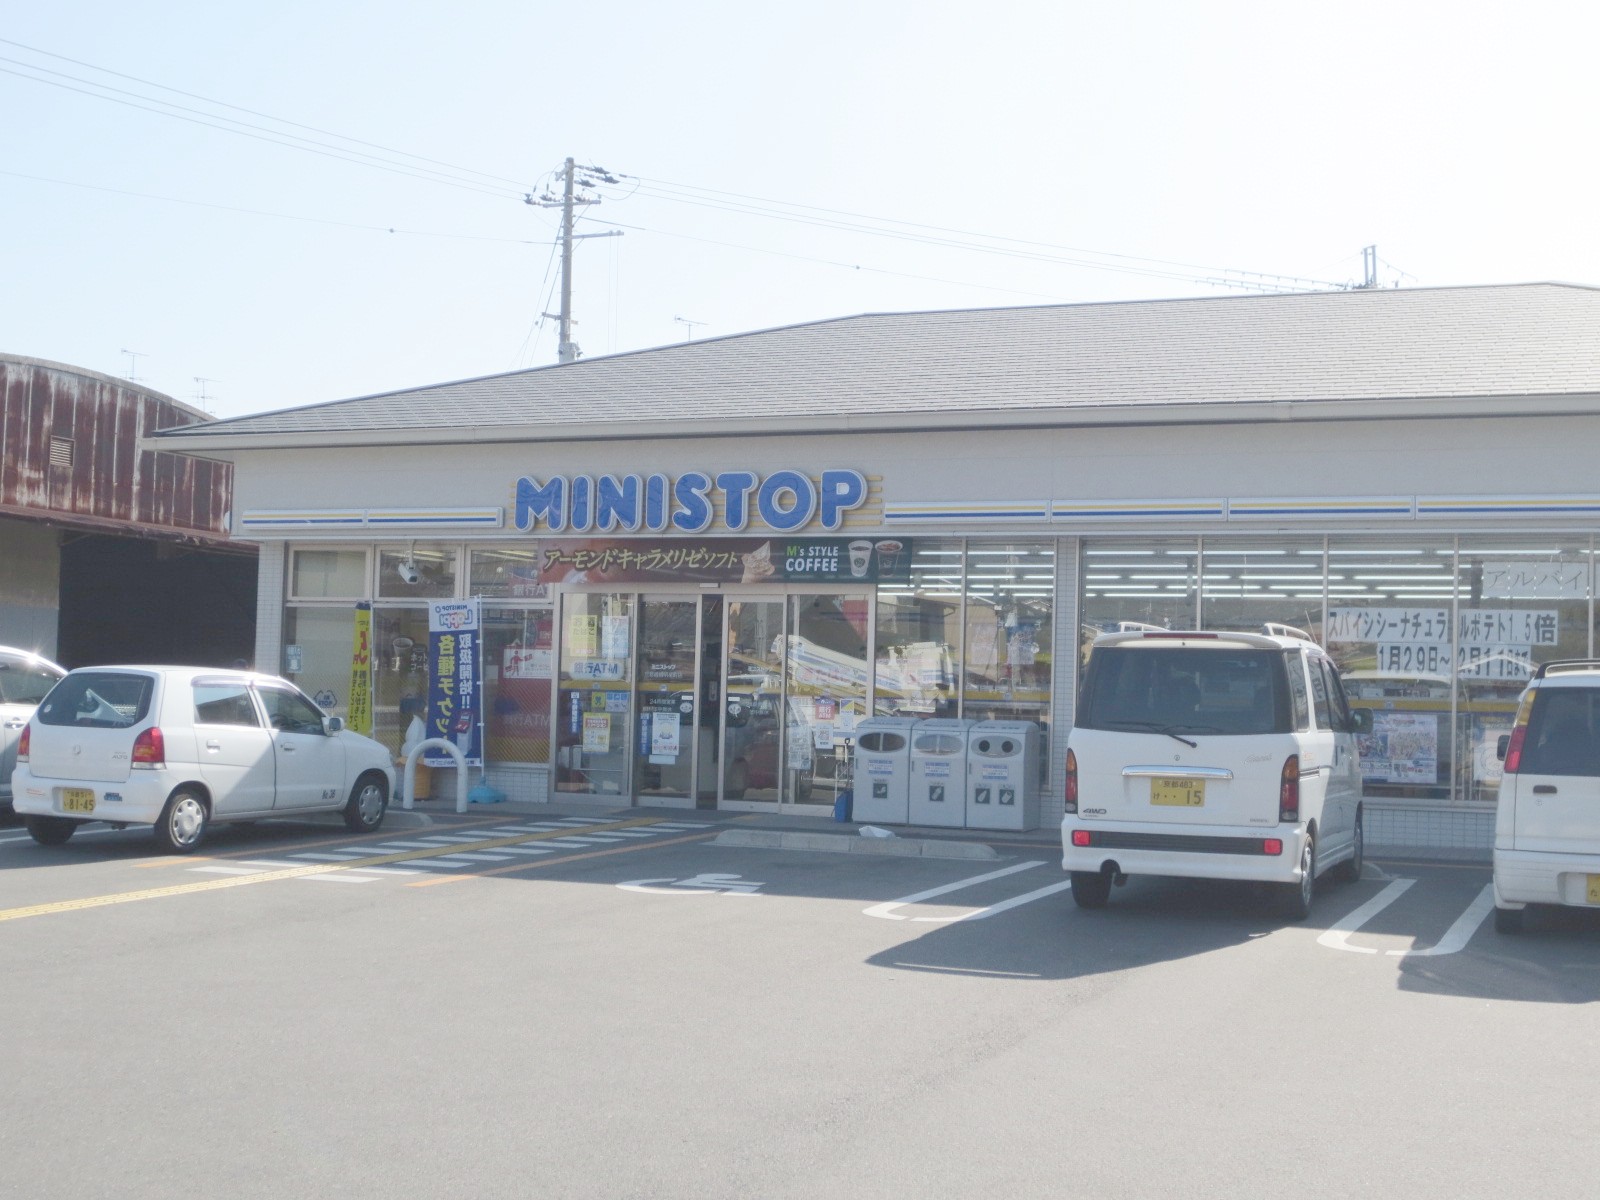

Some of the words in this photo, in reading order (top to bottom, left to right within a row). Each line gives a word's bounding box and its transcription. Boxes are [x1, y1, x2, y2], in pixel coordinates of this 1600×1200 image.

[515, 469, 868, 533] MINISTOP
[543, 548, 738, 571] アーモンドキャラメリゼソフト
[808, 545, 839, 557] STYLE
[785, 557, 839, 572] COFFEE
